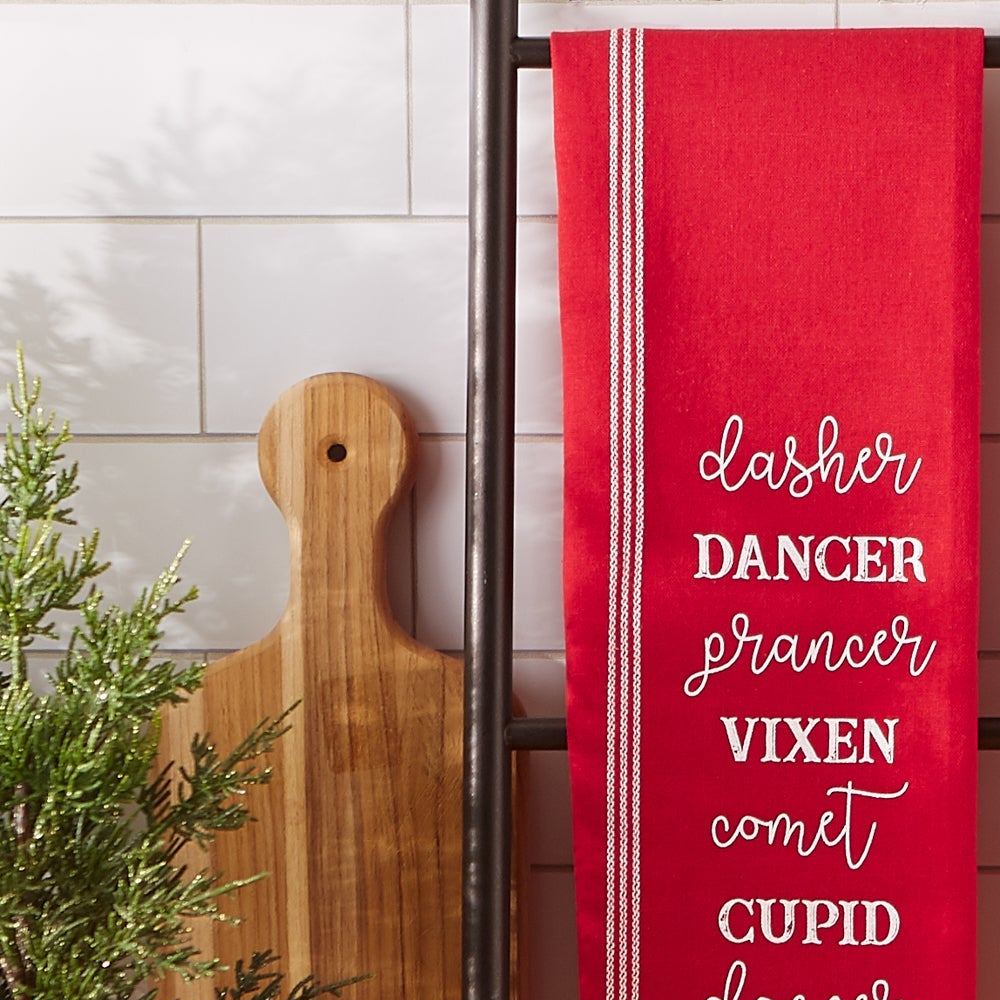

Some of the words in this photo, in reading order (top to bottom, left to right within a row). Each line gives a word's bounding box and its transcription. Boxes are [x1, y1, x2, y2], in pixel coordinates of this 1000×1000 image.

[700, 415, 922, 497] dasher
[693, 534, 926, 582] DANCER
[684, 613, 936, 696] prancer
[720, 717, 899, 763] VIXEN
[712, 781, 908, 869] comet
[719, 899, 900, 945] CUPID
